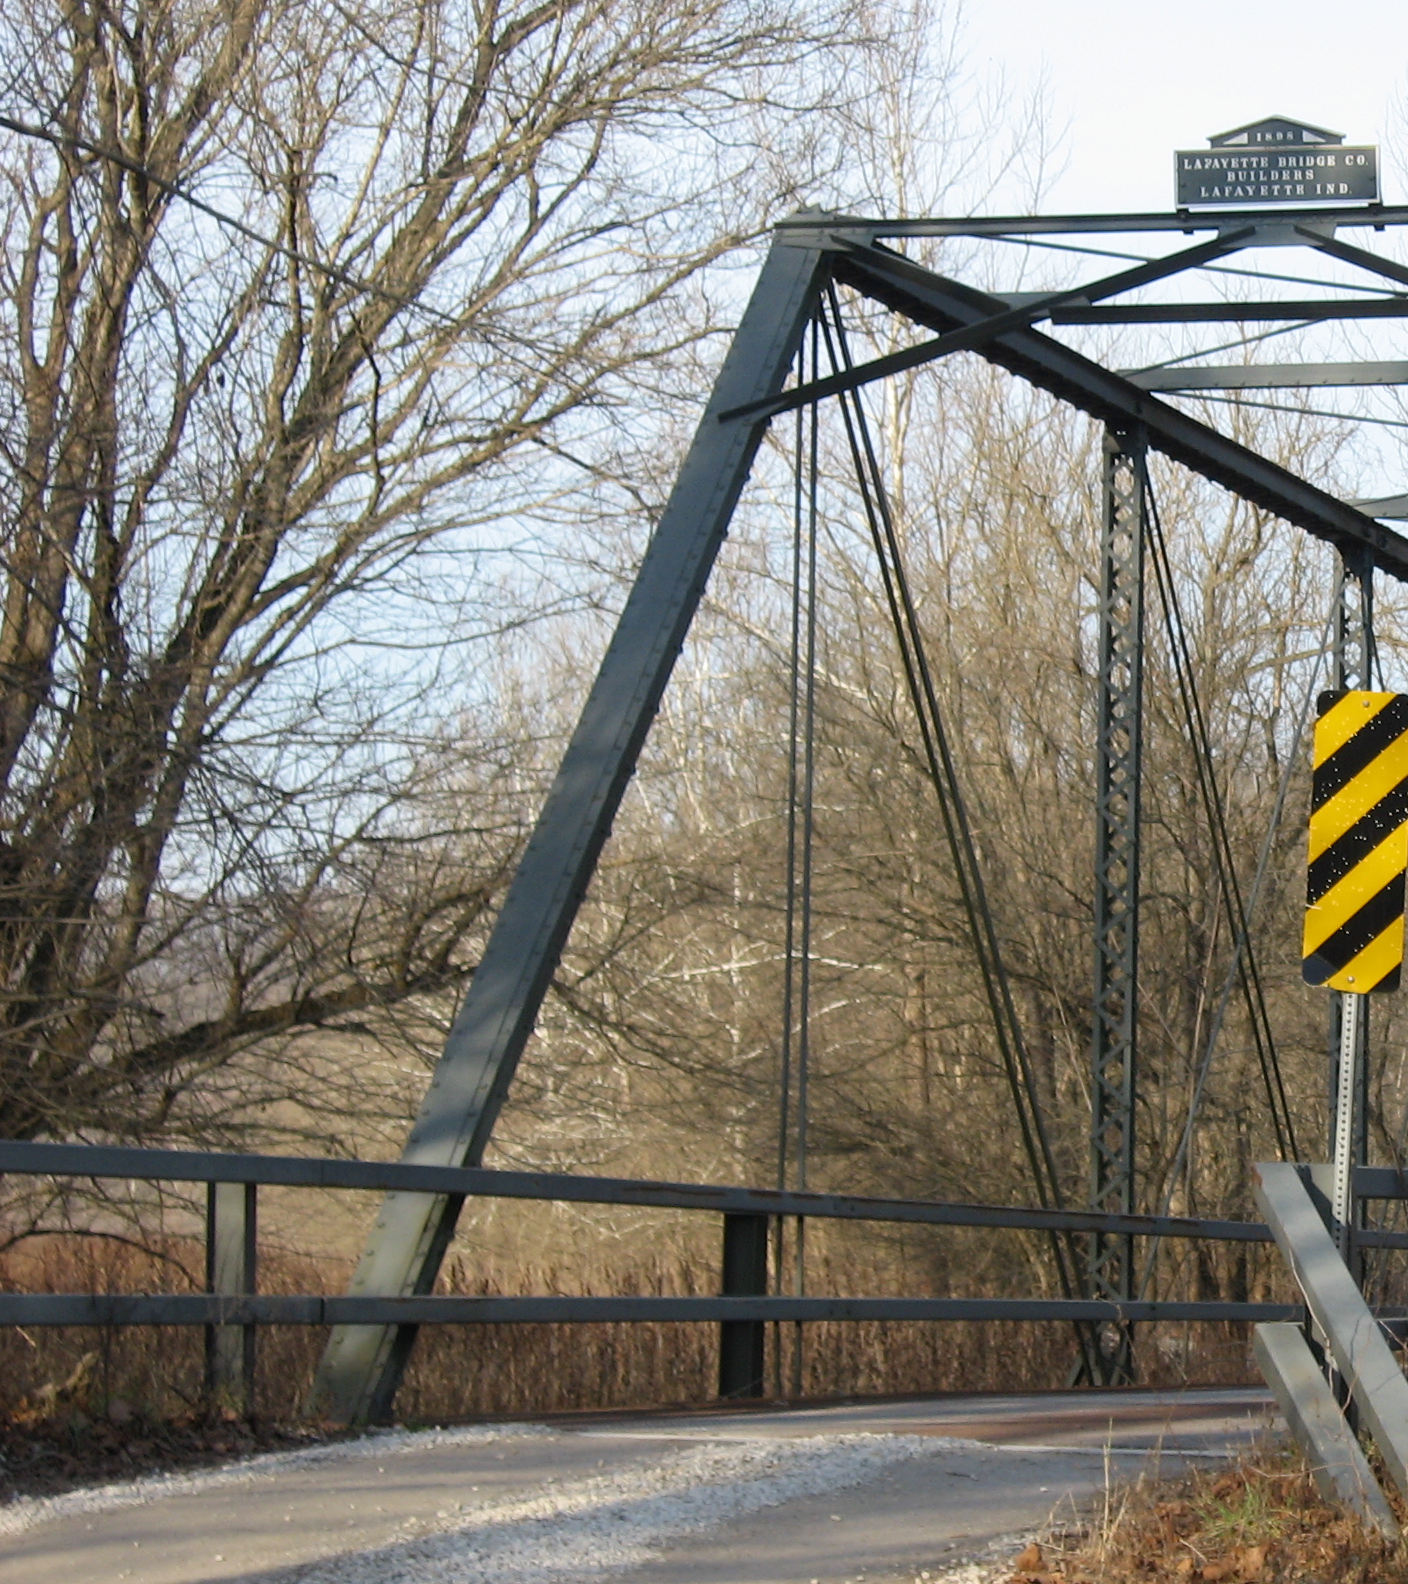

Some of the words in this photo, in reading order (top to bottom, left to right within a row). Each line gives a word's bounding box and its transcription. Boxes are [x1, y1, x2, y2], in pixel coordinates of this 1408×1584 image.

[1183, 157, 1269, 170] LAFAYETTE
[1278, 155, 1336, 168] BRIDGE
[1345, 154, 1369, 166] CO.
[1226, 169, 1315, 182] BUILDERS
[1200, 184, 1305, 198] LAFAYETTE
